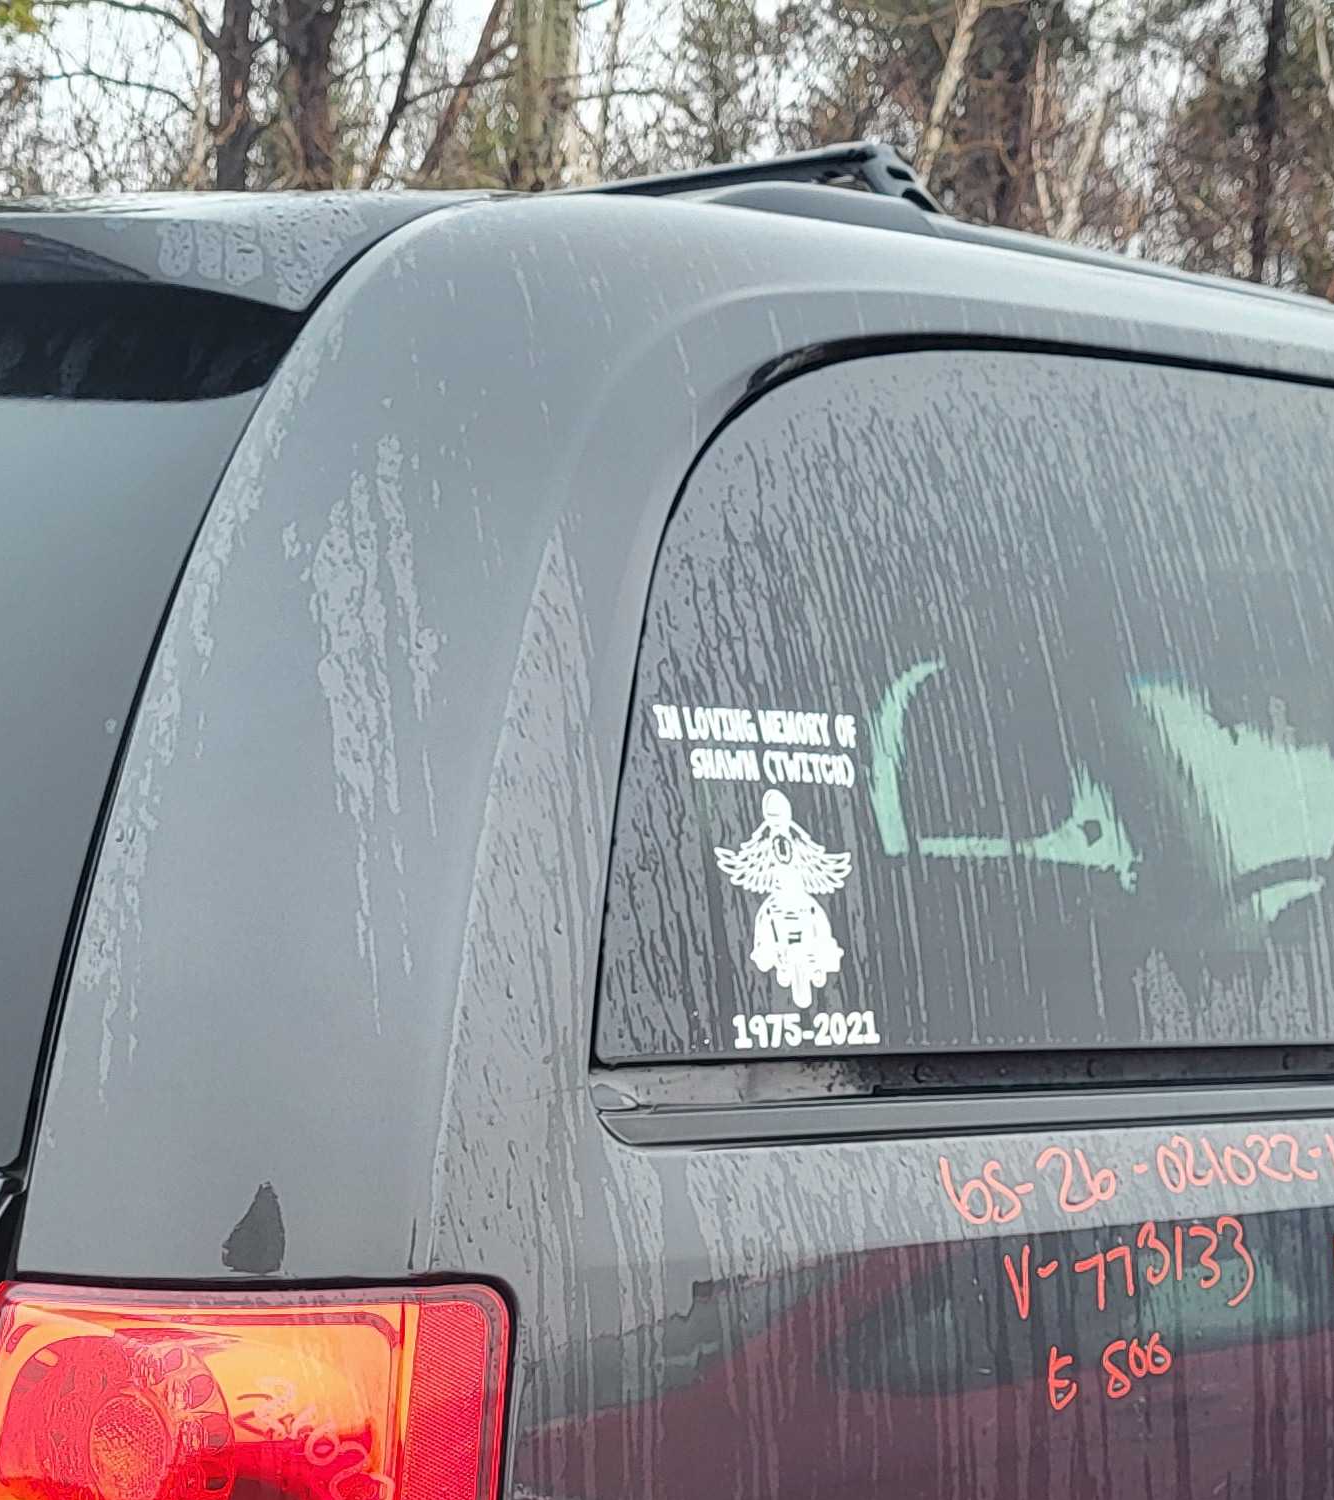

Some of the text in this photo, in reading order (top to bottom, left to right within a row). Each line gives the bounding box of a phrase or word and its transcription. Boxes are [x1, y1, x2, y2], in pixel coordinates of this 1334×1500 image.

[652, 704, 857, 749] IN LOVING MEMORY OF
[690, 748, 855, 788] SHAWN (TWITCH)
[732, 1011, 880, 1050] 1975-2021
